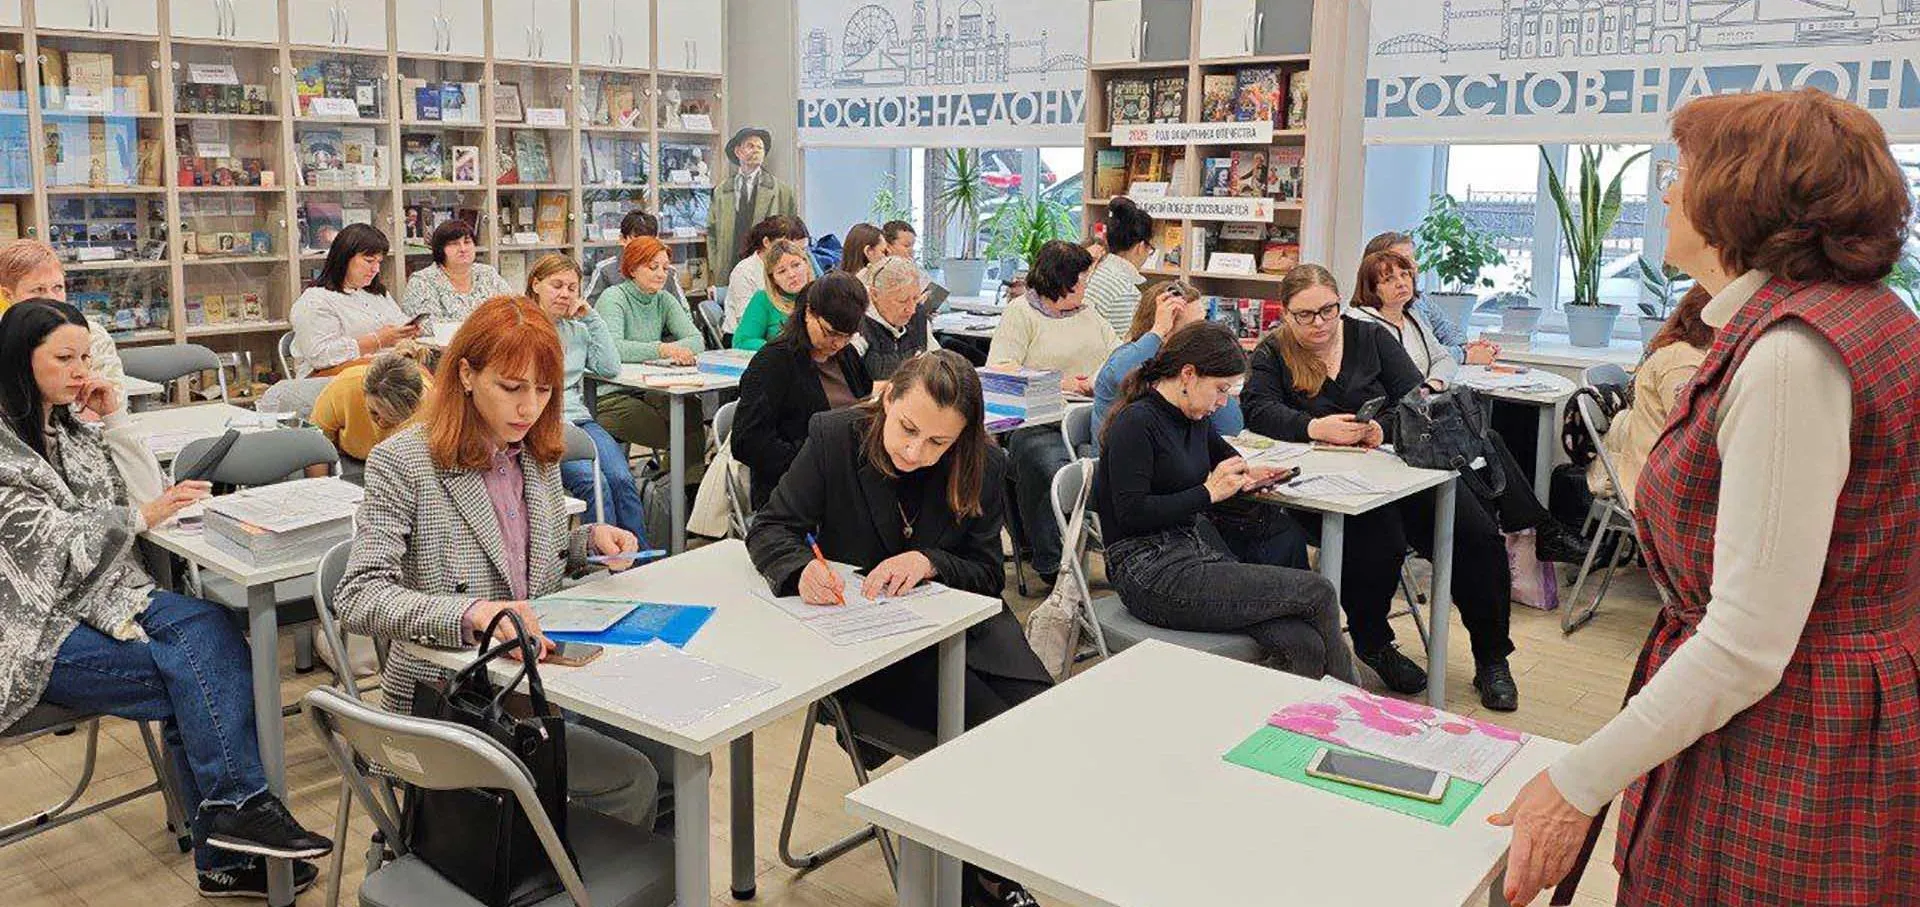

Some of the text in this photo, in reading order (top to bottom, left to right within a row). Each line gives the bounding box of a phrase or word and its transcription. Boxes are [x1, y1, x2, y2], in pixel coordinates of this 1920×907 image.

[802, 88, 1087, 129] РОСТОВ-НА-ДОНУ
[1128, 129, 1149, 141] 2025
[1215, 127, 1257, 139] ОТЕЧЕСТВА
